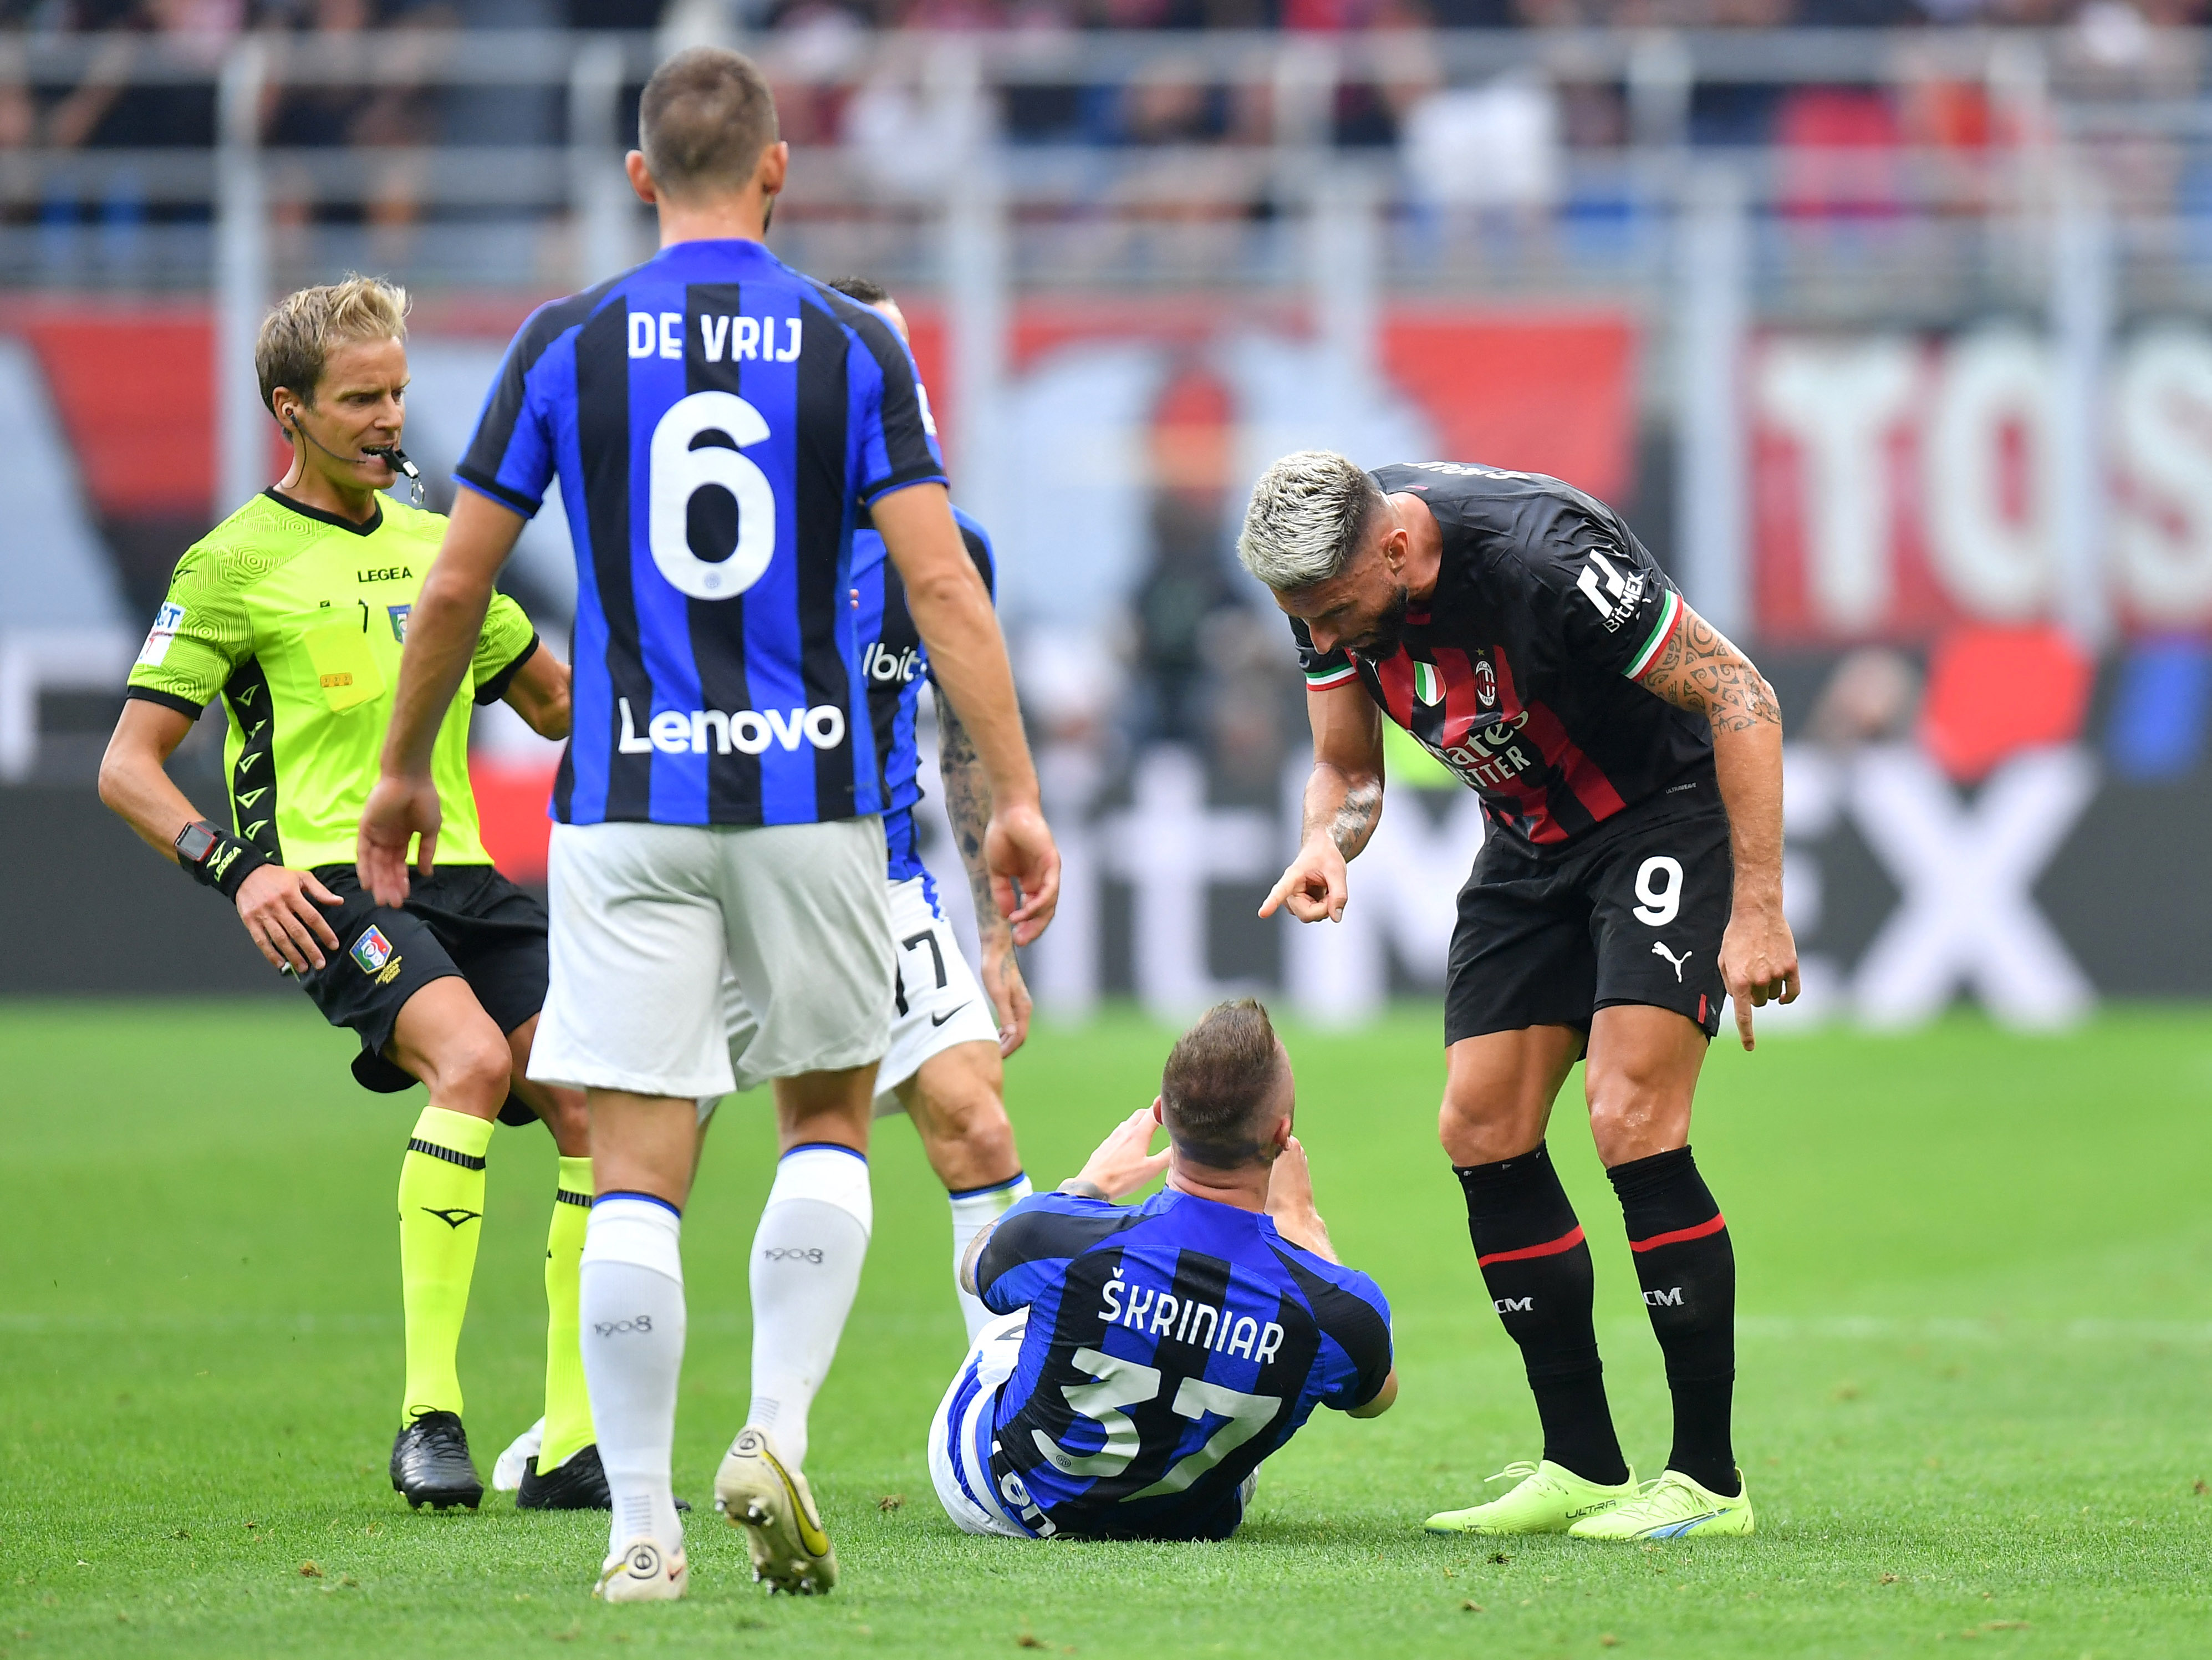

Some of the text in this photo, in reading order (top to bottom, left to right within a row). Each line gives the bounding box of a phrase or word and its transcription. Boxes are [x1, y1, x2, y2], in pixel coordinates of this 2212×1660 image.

[628, 312, 802, 362] DE VRIJ
[649, 390, 776, 601] 6
[358, 566, 413, 582] LEGEA
[1602, 571, 1644, 633] BitMEX
[863, 642, 921, 683] lbit
[618, 696, 845, 755] Lenovo
[214, 846, 242, 883] LEGEA
[1632, 856, 1684, 926] 9
[764, 1247, 824, 1264] 1908
[1098, 1267, 1285, 1364] ŠKRINIAR
[1494, 1296, 1534, 1314] CM
[1643, 1287, 1685, 1306] CM
[594, 1315, 653, 1338] 1908
[1032, 1347, 1282, 1503] 37
[1566, 1499, 1617, 1519] ULTRA
